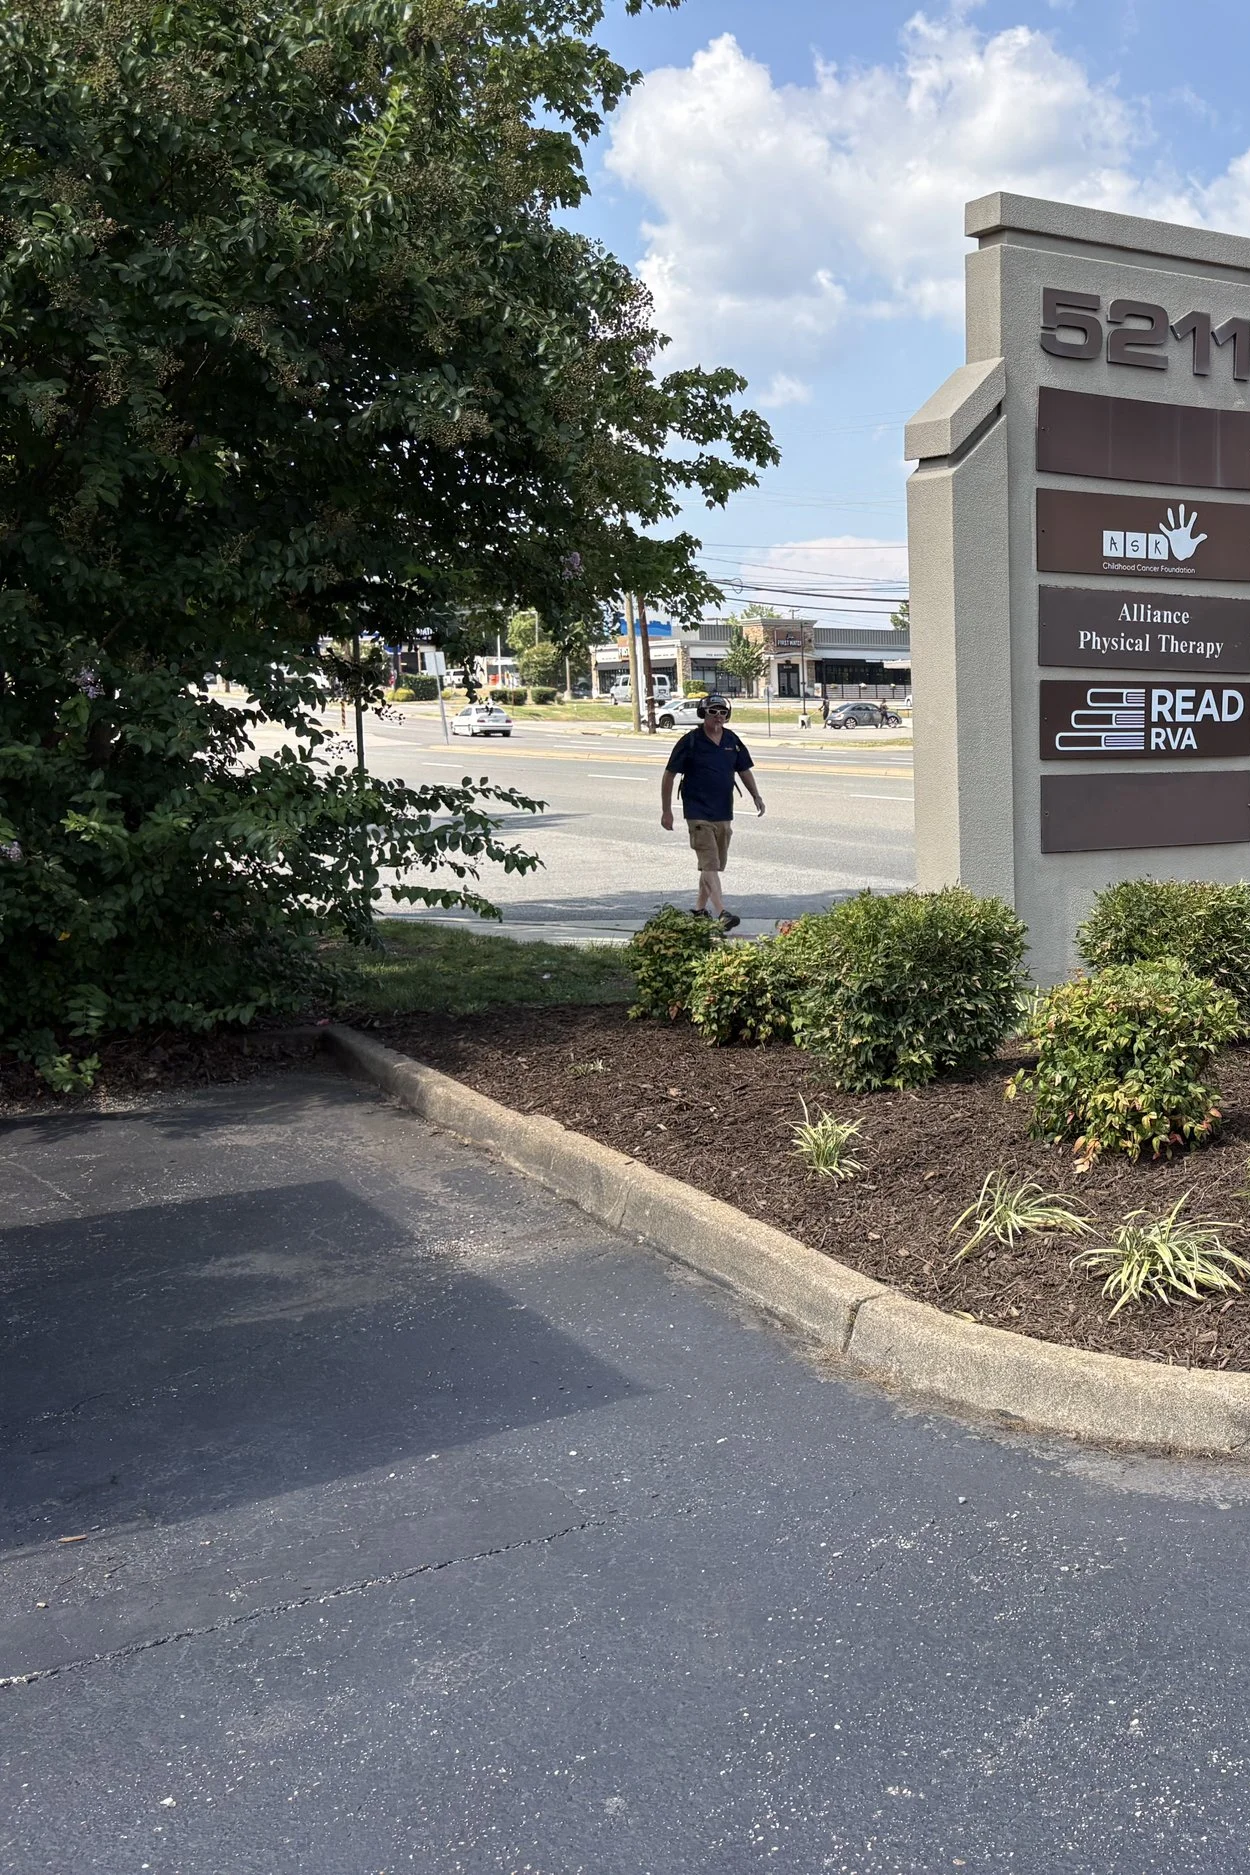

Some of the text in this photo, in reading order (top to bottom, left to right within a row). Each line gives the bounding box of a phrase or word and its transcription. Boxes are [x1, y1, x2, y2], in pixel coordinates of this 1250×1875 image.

[1040, 286, 1250, 382] 5211
[1110, 536, 1162, 555] ASK
[1102, 561, 1196, 574] Childhood Cancer Foundation
[1118, 603, 1190, 625] Alliance
[1078, 630, 1224, 659] Physical Therapy
[1151, 688, 1245, 722] READ
[1151, 727, 1198, 750] RVA
